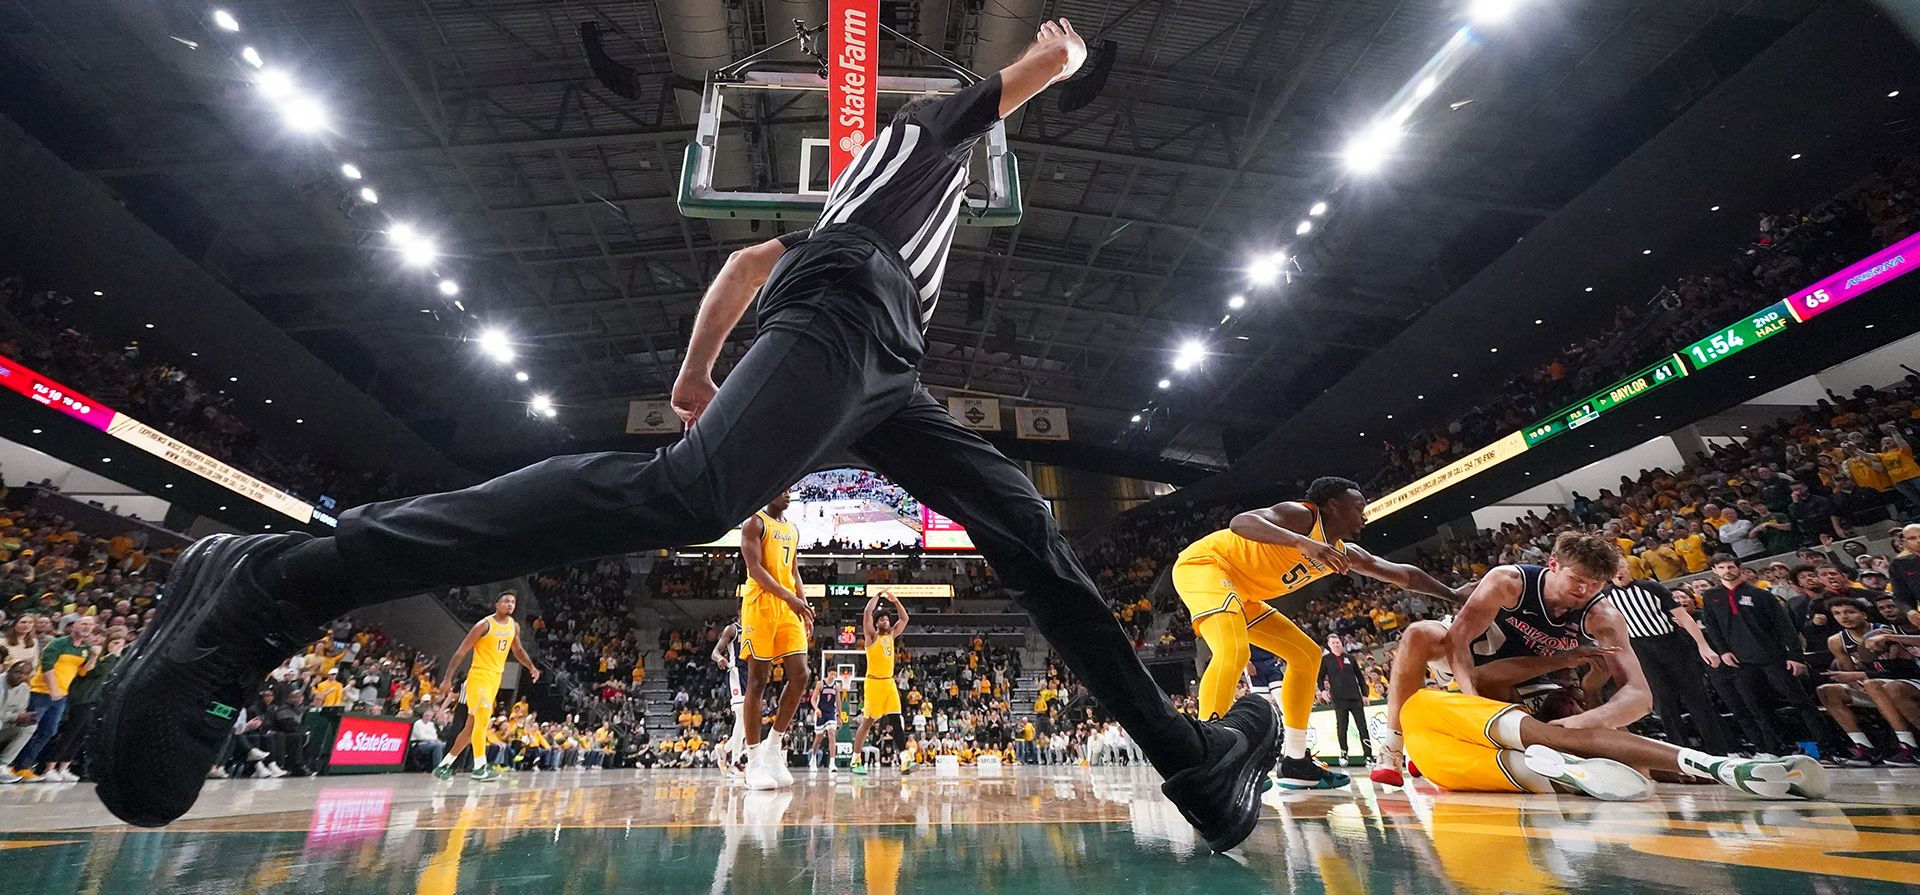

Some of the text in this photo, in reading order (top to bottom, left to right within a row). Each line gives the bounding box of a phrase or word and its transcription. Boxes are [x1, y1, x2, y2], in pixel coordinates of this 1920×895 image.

[1844, 254, 1905, 290] ARIZONA
[1805, 288, 1830, 308] 65
[1752, 311, 1779, 329] 2ND
[1755, 318, 1788, 338] HALF
[1692, 329, 1744, 363] 1:54
[32, 383, 49, 395] FLS
[48, 389, 63, 401] 10
[1609, 365, 1673, 403] BAYLOR 61
[1569, 404, 1591, 421] FLS 7
[782, 545, 790, 564] 7
[1505, 616, 1579, 651] ARIZONA
[497, 639, 508, 652] 13
